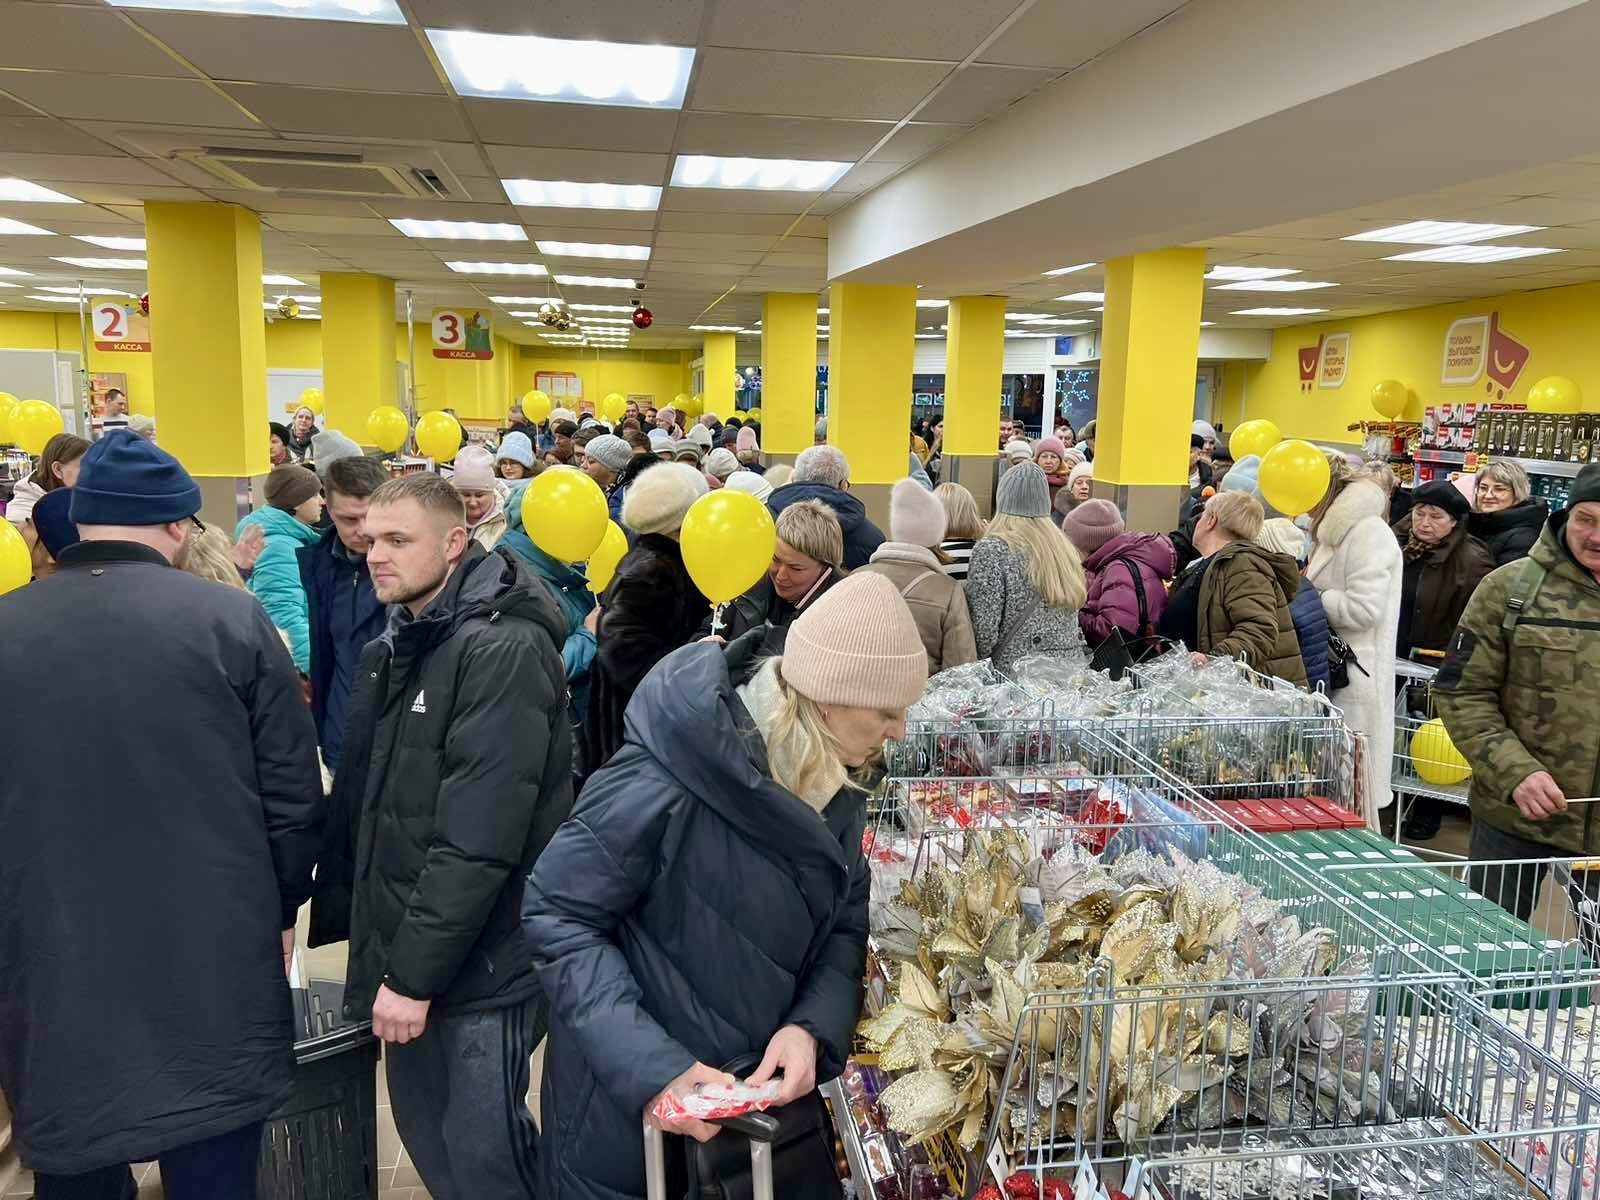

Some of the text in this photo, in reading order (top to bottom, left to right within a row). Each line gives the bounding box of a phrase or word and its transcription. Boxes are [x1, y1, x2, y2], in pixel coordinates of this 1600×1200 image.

[100, 307, 123, 337] 2
[439, 314, 459, 344] 3
[113, 343, 143, 351] КАССА
